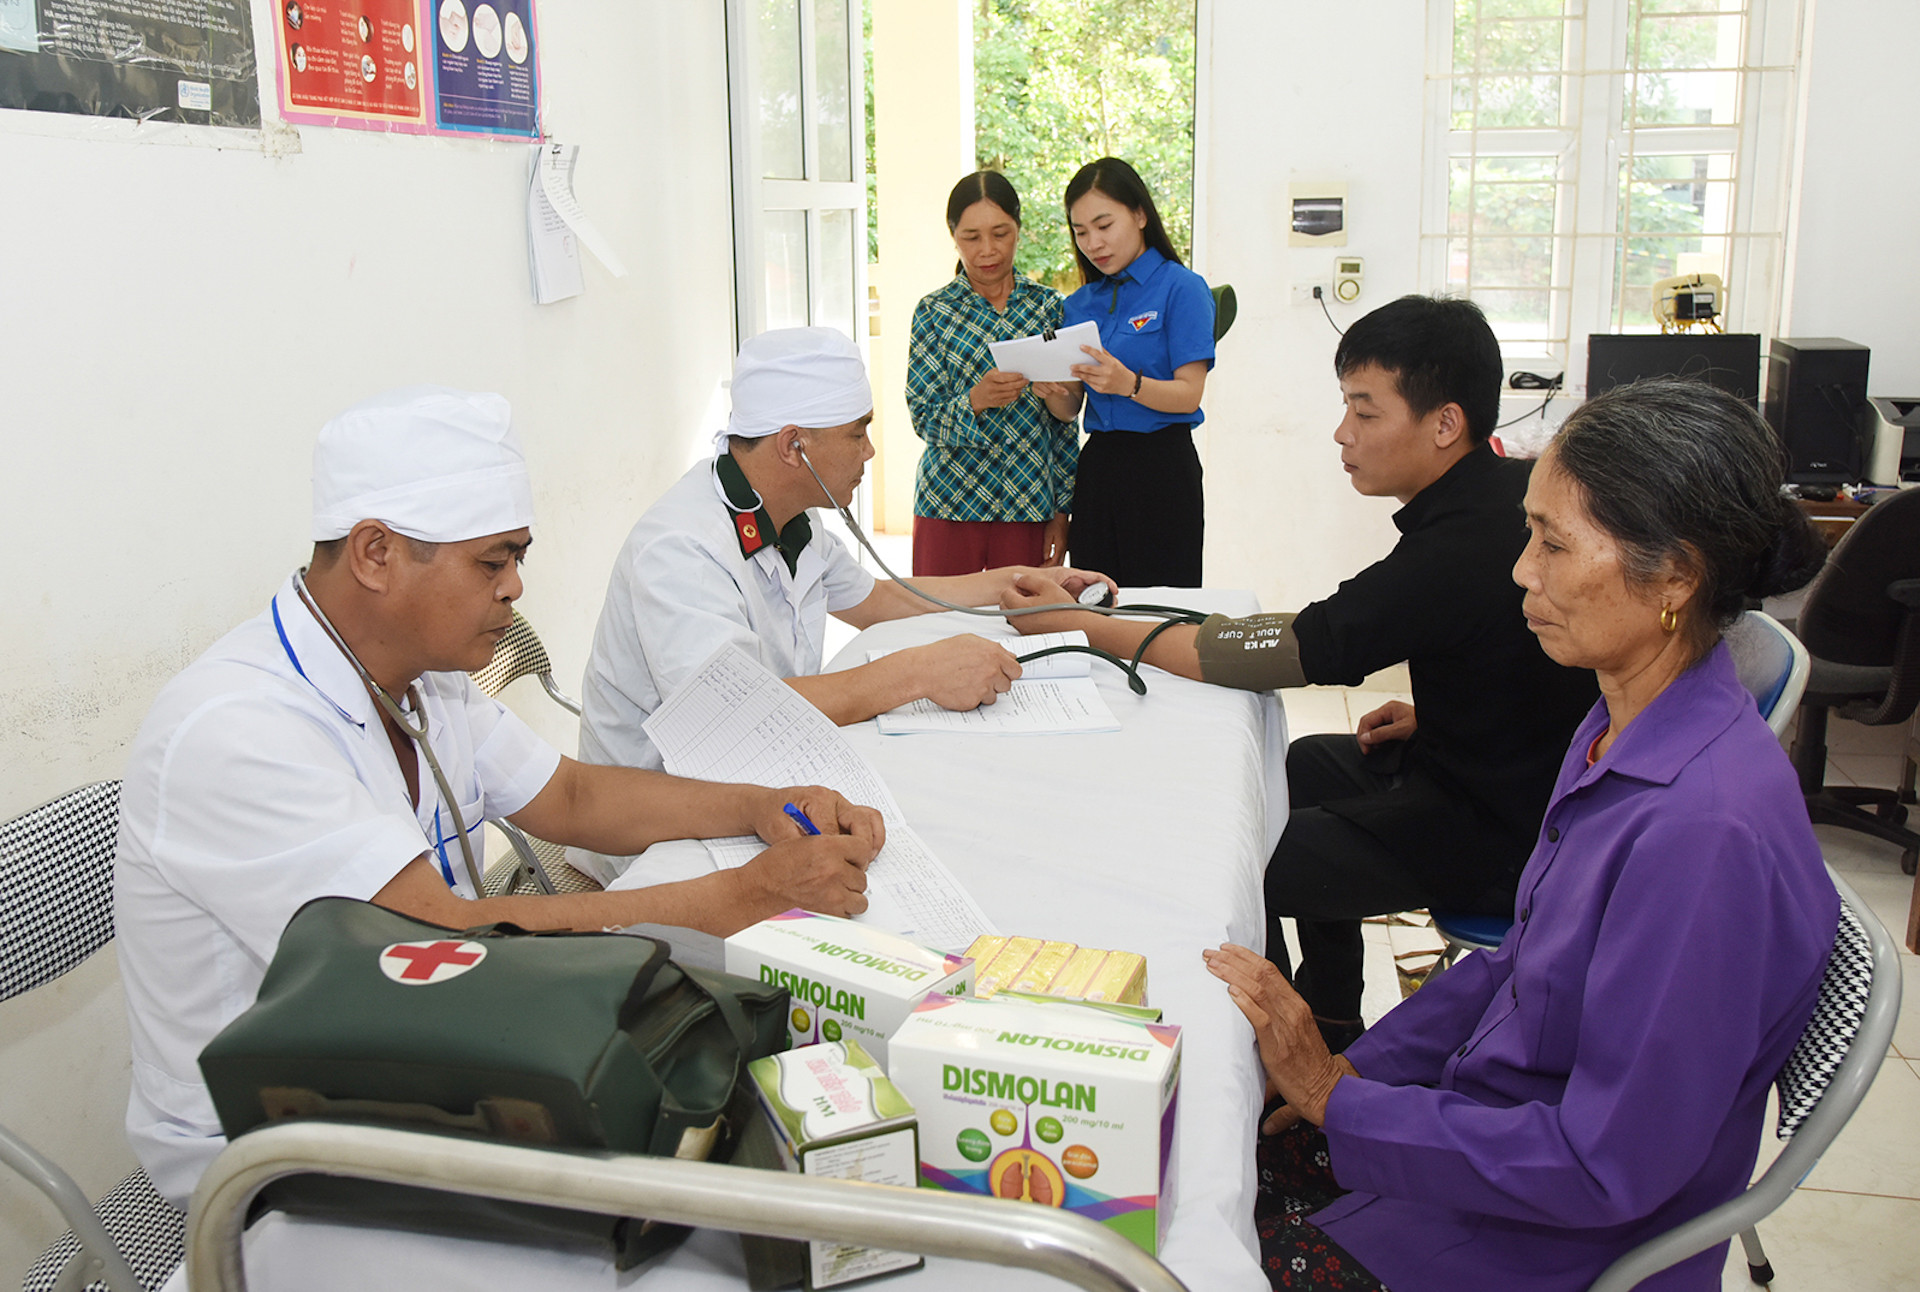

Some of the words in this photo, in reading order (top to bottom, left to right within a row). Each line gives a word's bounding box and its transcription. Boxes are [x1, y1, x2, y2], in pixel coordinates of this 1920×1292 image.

[1217, 630, 1244, 639] CUFF
[1249, 628, 1282, 639] ADULT
[811, 941, 929, 982] DISMOLAN
[997, 1031, 1150, 1062] DISMOLAN
[943, 1064, 1096, 1112] DISMOLAN
[1062, 1114, 1078, 1124] 200
[1080, 1117, 1110, 1129] mg/10
[1111, 1122, 1125, 1130] ml
